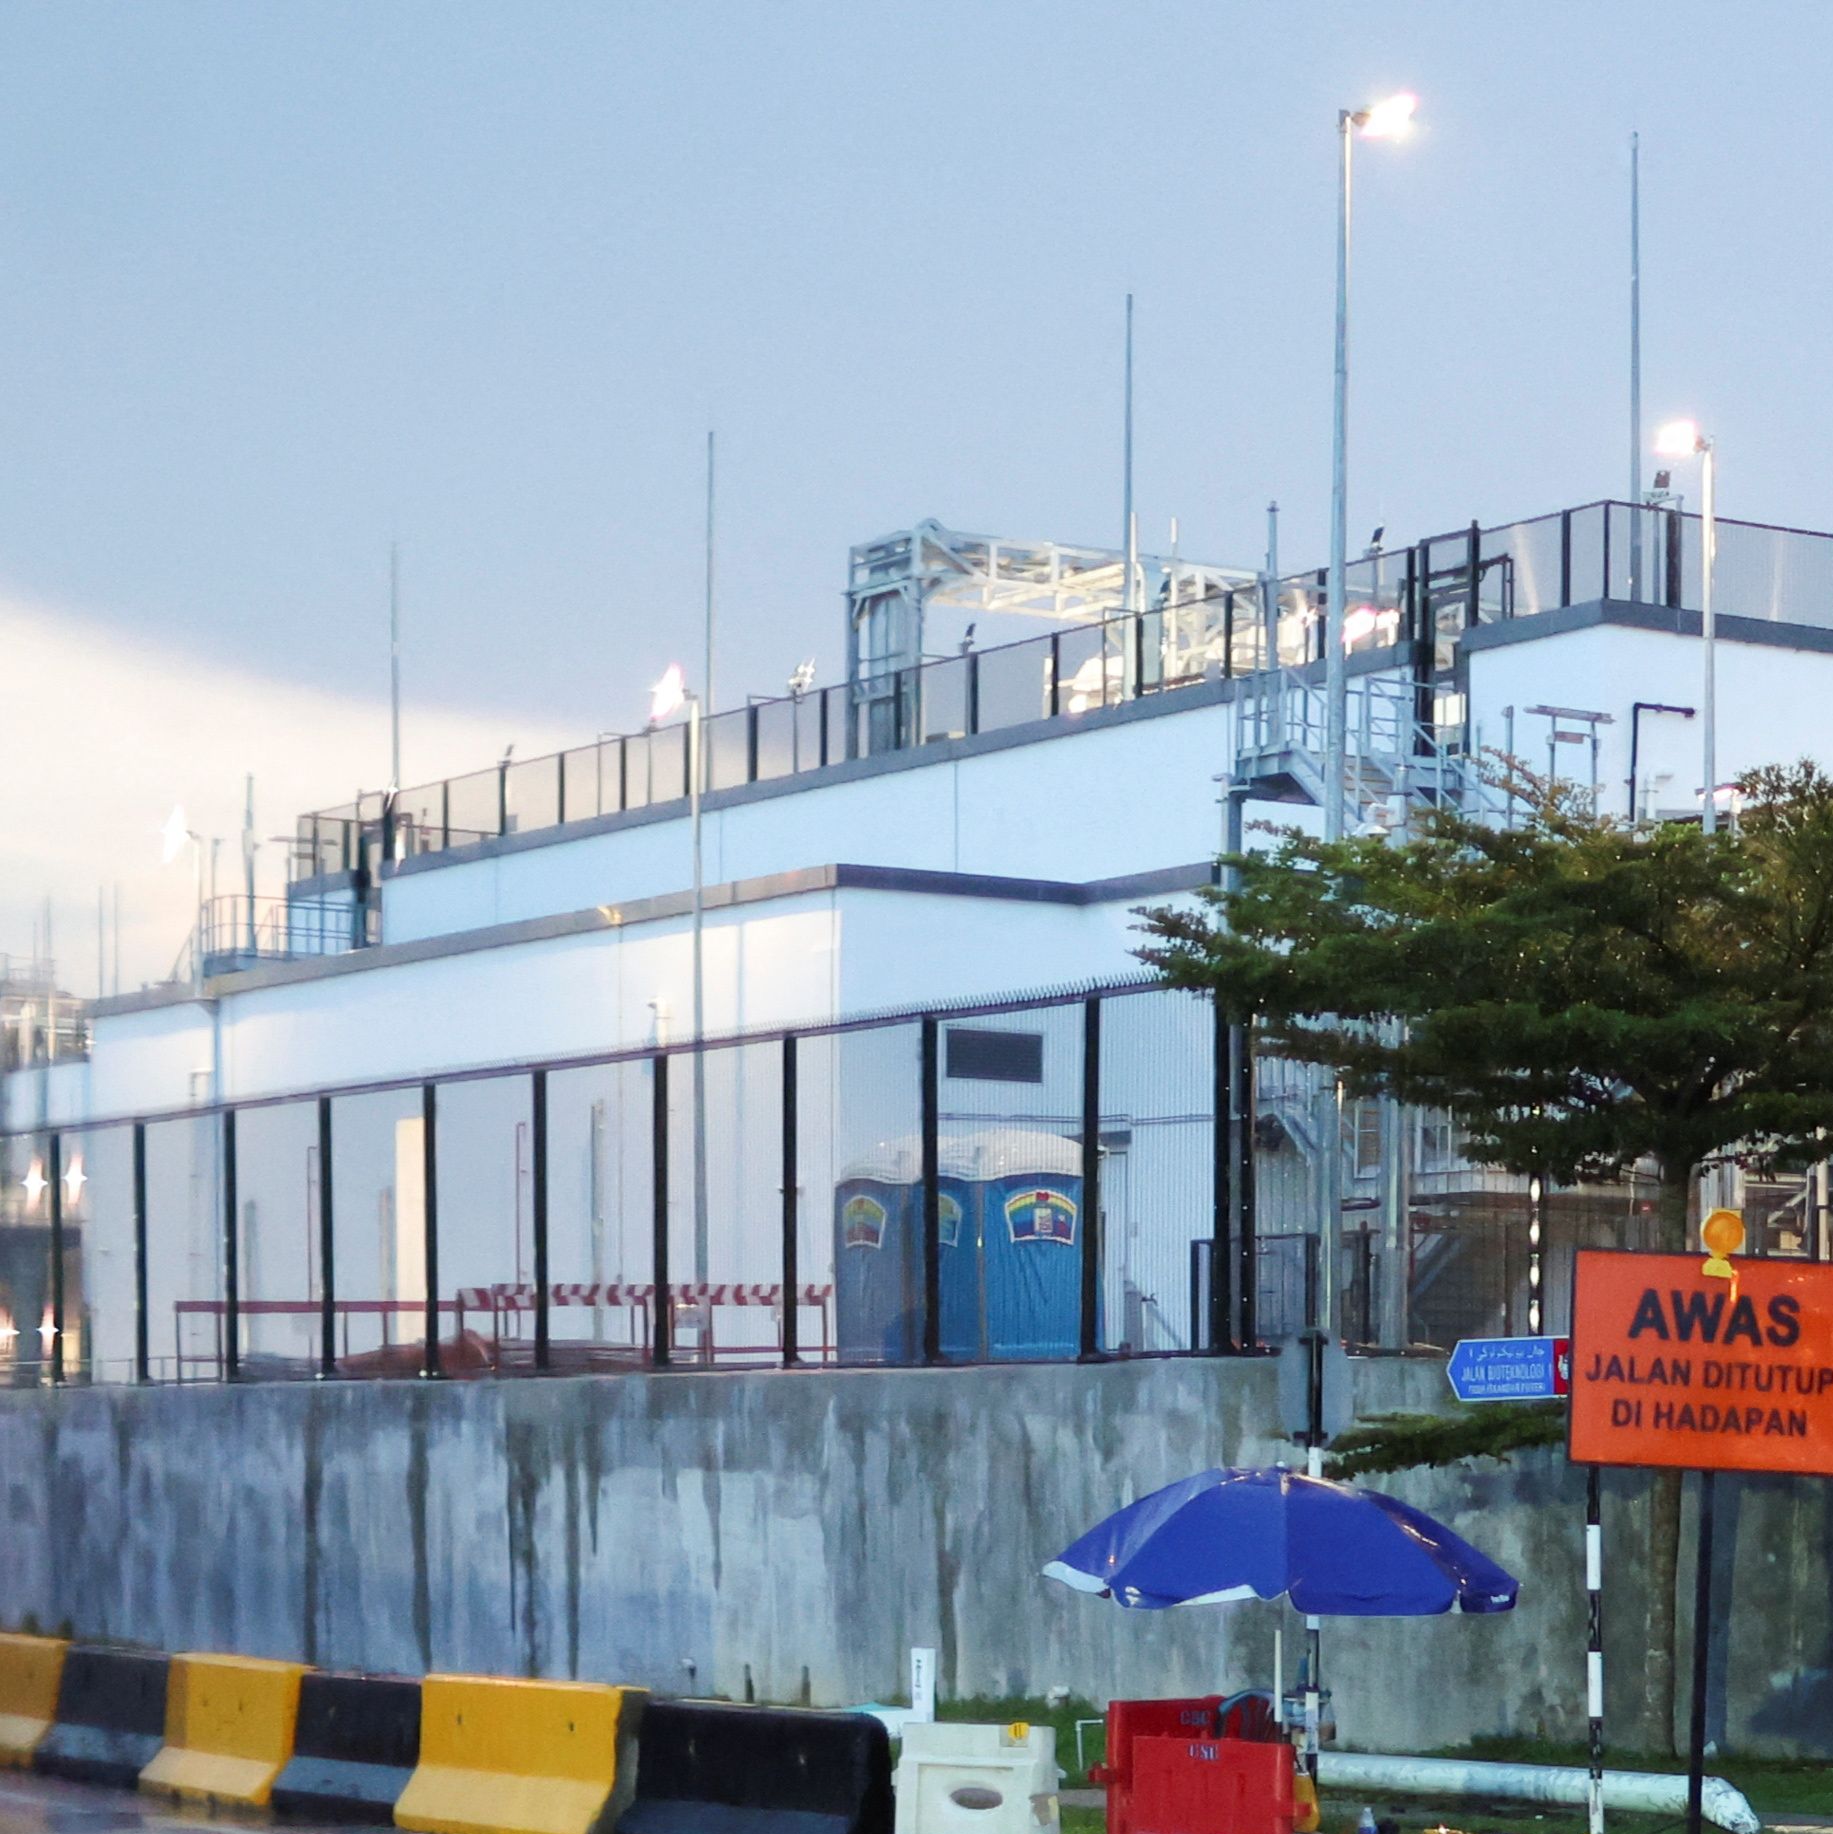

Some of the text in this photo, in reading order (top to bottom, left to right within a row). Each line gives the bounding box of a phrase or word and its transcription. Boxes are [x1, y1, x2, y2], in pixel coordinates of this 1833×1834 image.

[1627, 1287, 1801, 1348] AWAS
[1461, 1365, 1486, 1382] JALAN
[1585, 1353, 1691, 1387] JALAN
[1611, 1398, 1808, 1438] DI HADAPAN
